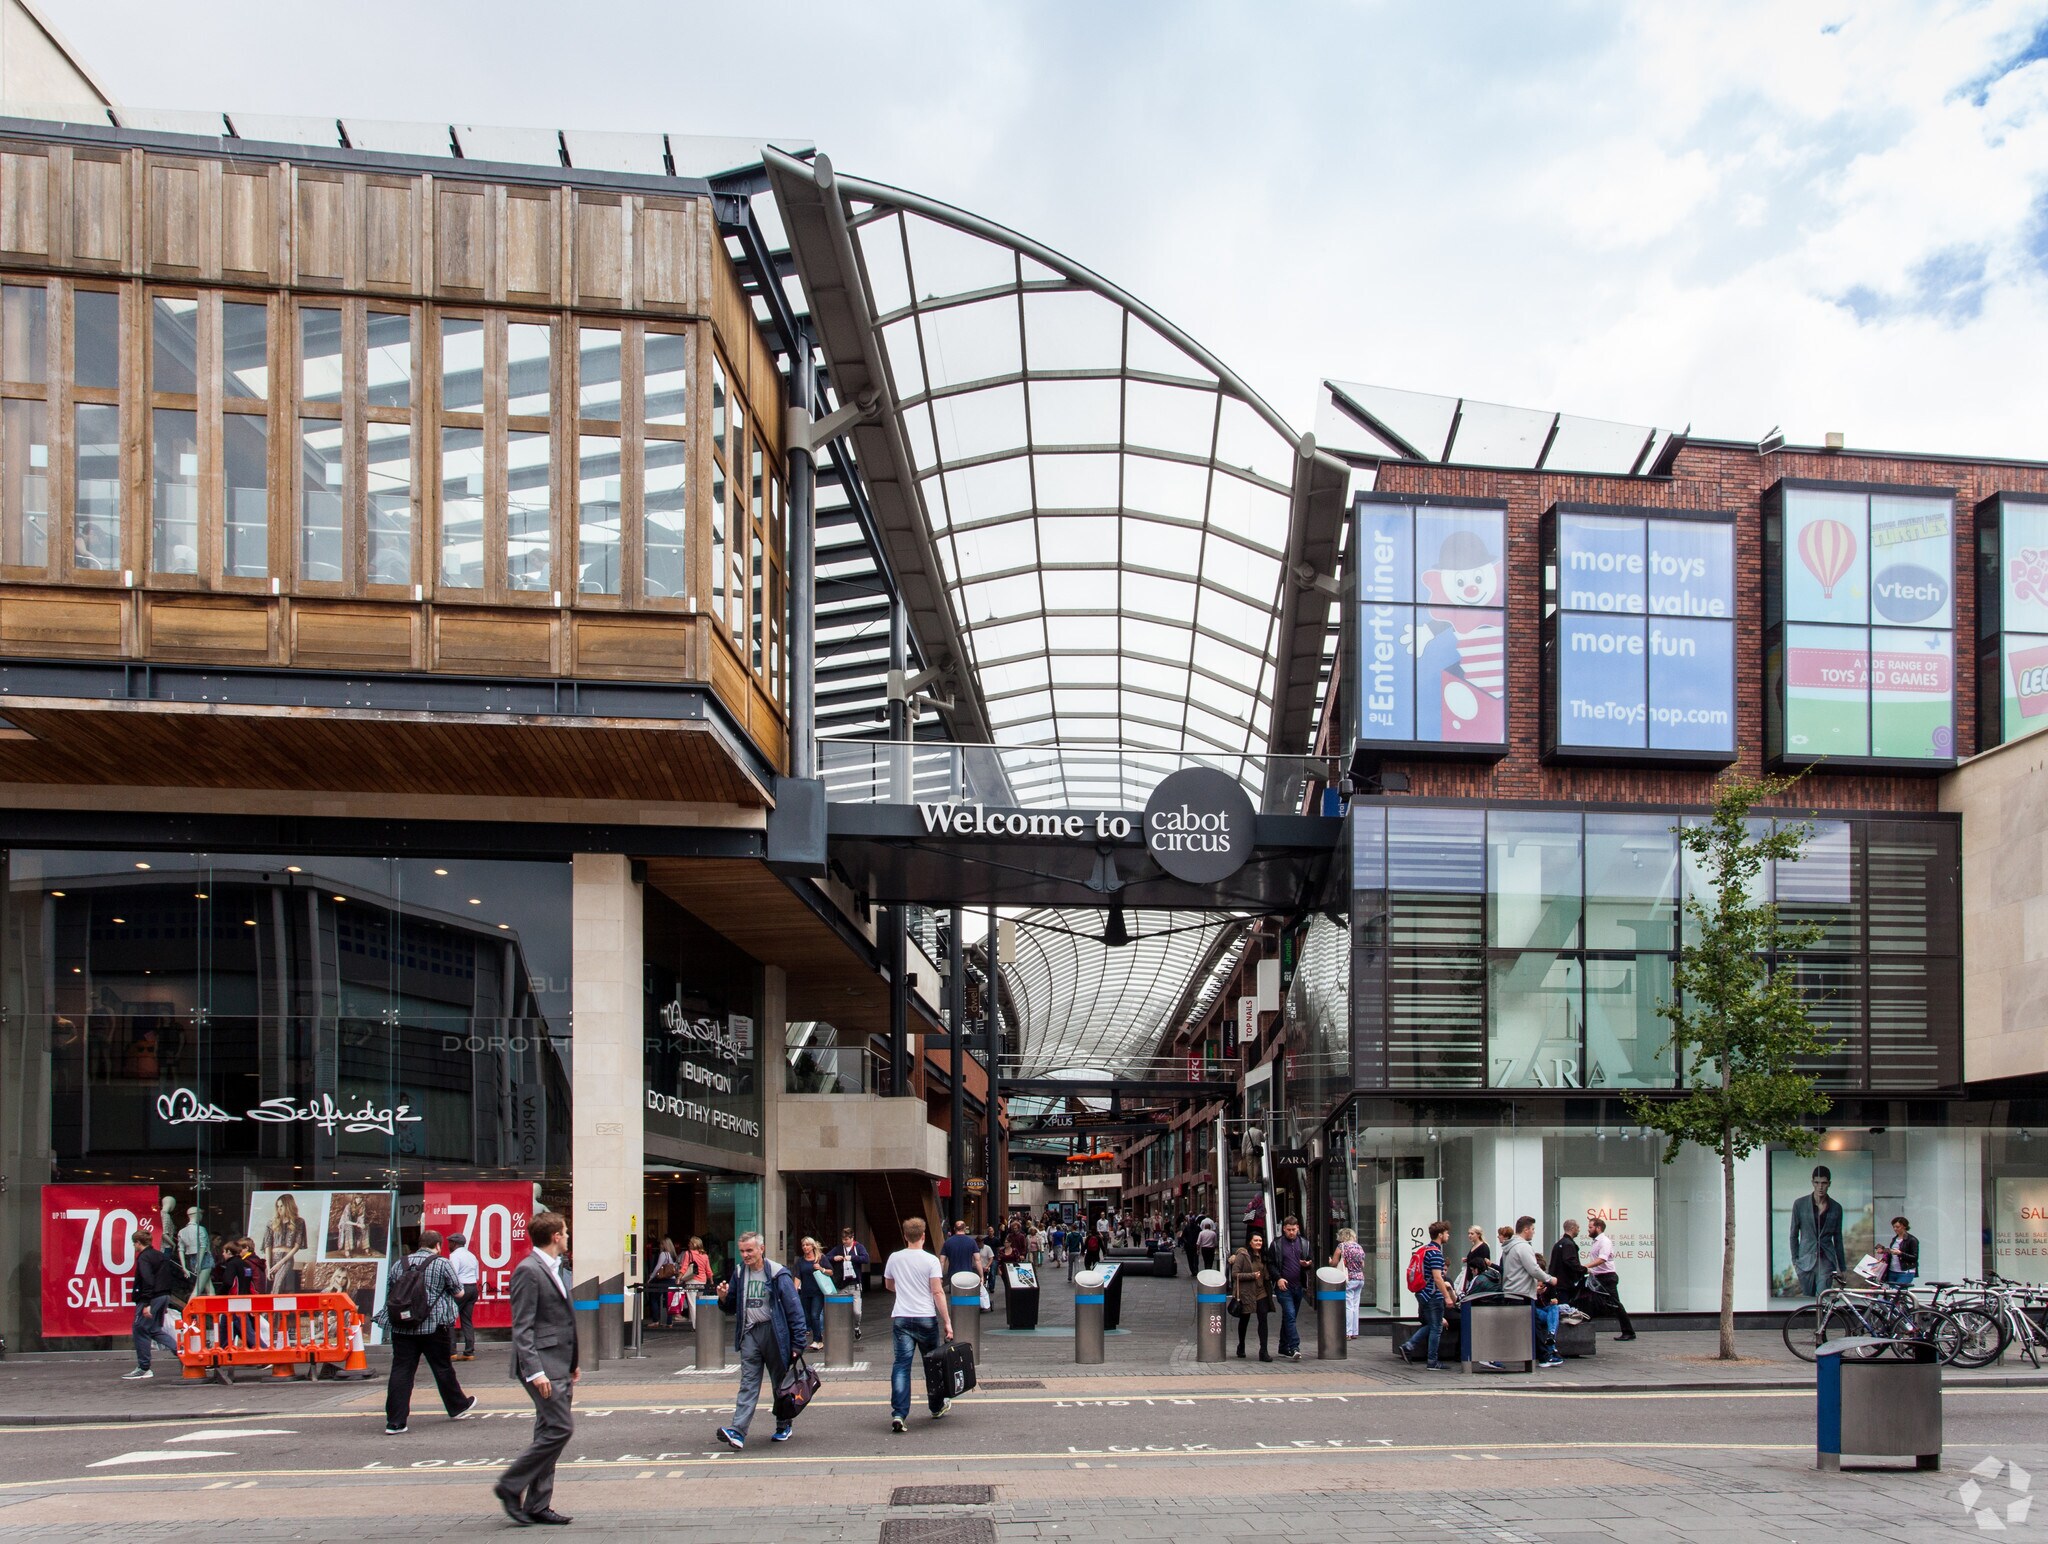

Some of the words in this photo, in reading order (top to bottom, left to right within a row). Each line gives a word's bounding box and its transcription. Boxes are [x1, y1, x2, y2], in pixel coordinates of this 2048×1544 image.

[1571, 551, 1643, 574] more
[1650, 551, 1706, 583] toys
[1571, 590, 1643, 614] more
[1650, 590, 1725, 616] value
[1877, 583, 1940, 601] vtech
[1367, 530, 1394, 710] Entertainer
[1571, 632, 1643, 655] more
[1650, 630, 1696, 657] fun
[1821, 669, 1855, 682] TOYS
[1890, 672, 1938, 686] GAMES
[1854, 659, 1862, 668] A
[1888, 660, 1921, 671] RANGE
[1925, 661, 1938, 671] OF
[916, 802, 1084, 838] Welcome
[1097, 811, 1131, 838] to
[1151, 804, 1230, 832] cabot
[1151, 832, 1231, 852] circus
[968, 988, 979, 1012] dwell
[1494, 1058, 1607, 1089] ZARA
[157, 1087, 243, 1125] Miss
[246, 1093, 423, 1136] Selfridge
[648, 1089, 710, 1124] DOROTHY
[712, 1110, 759, 1138] PERKINS
[1279, 1156, 1306, 1164] ZARA
[433, 1207, 441, 1215] UP
[441, 1207, 447, 1215] TO
[1587, 1208, 1628, 1221] SALE
[513, 1230, 525, 1238] OFF
[2014, 1248, 2038, 1256] SALE
[66, 1277, 137, 1308] SALE
